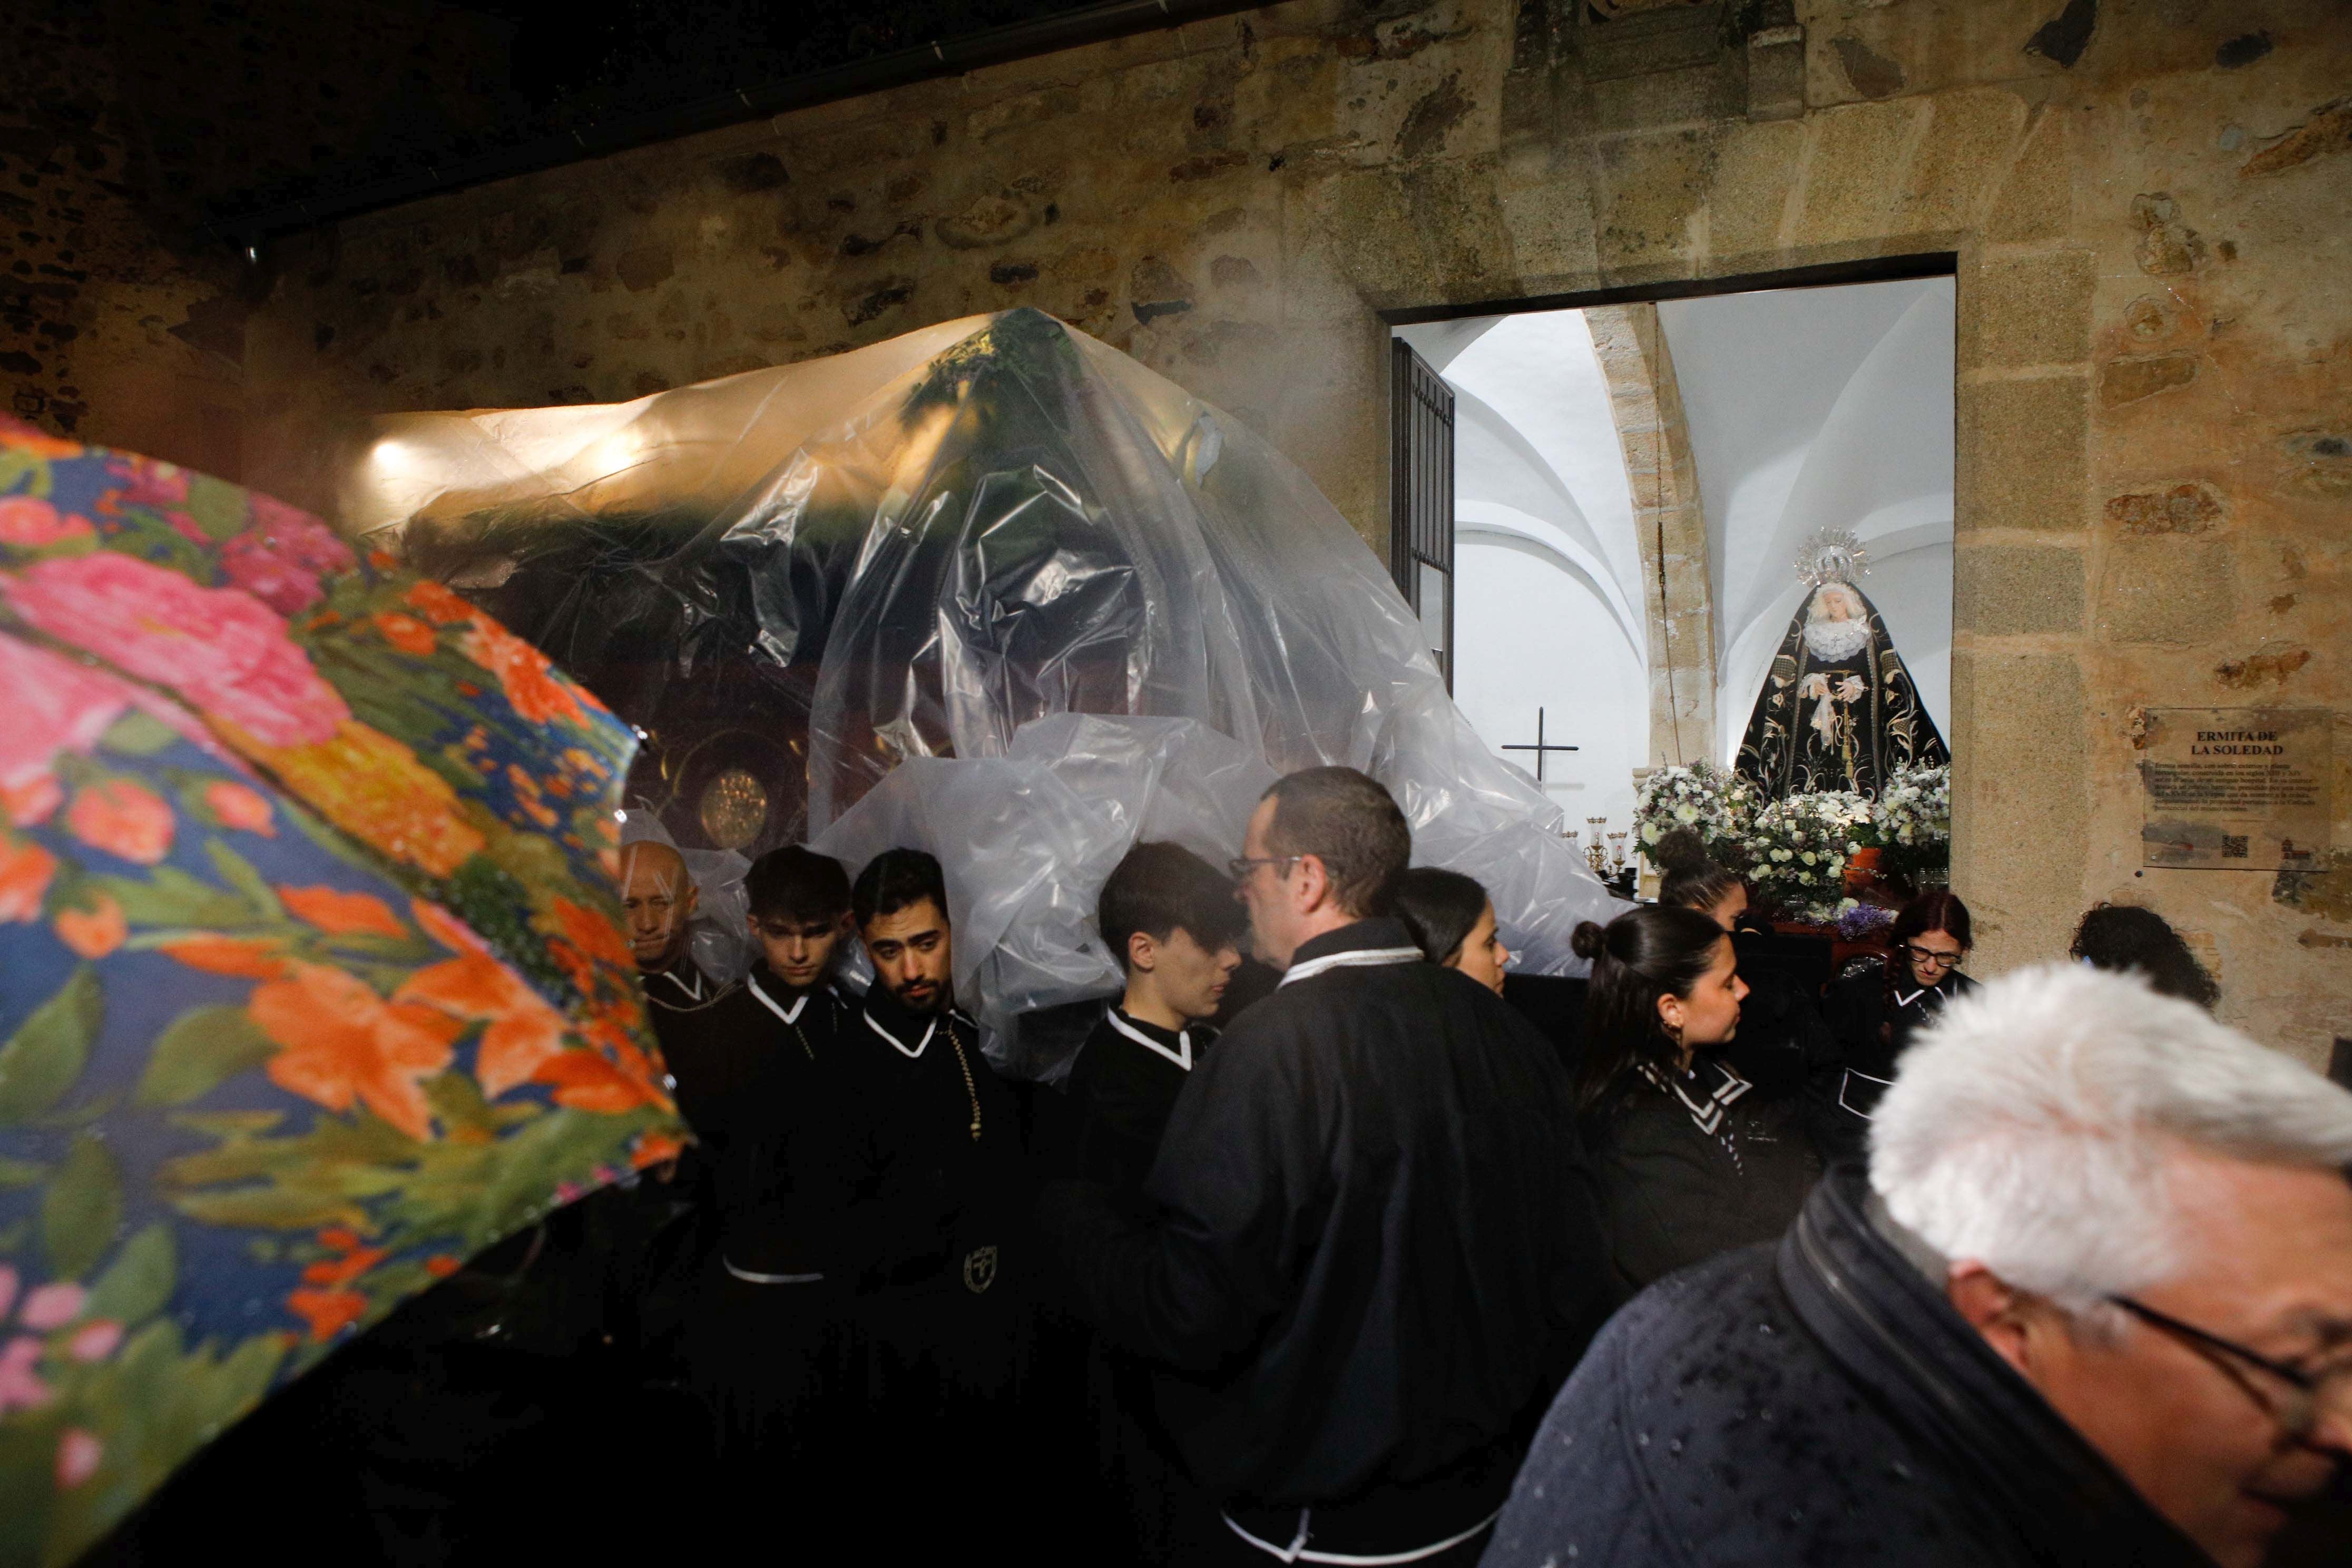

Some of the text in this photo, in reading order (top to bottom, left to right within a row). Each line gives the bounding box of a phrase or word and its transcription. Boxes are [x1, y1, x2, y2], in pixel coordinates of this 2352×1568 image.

[2196, 731, 2278, 741] ERMITA DE
[2191, 744, 2284, 754] LA SOLEDAD
